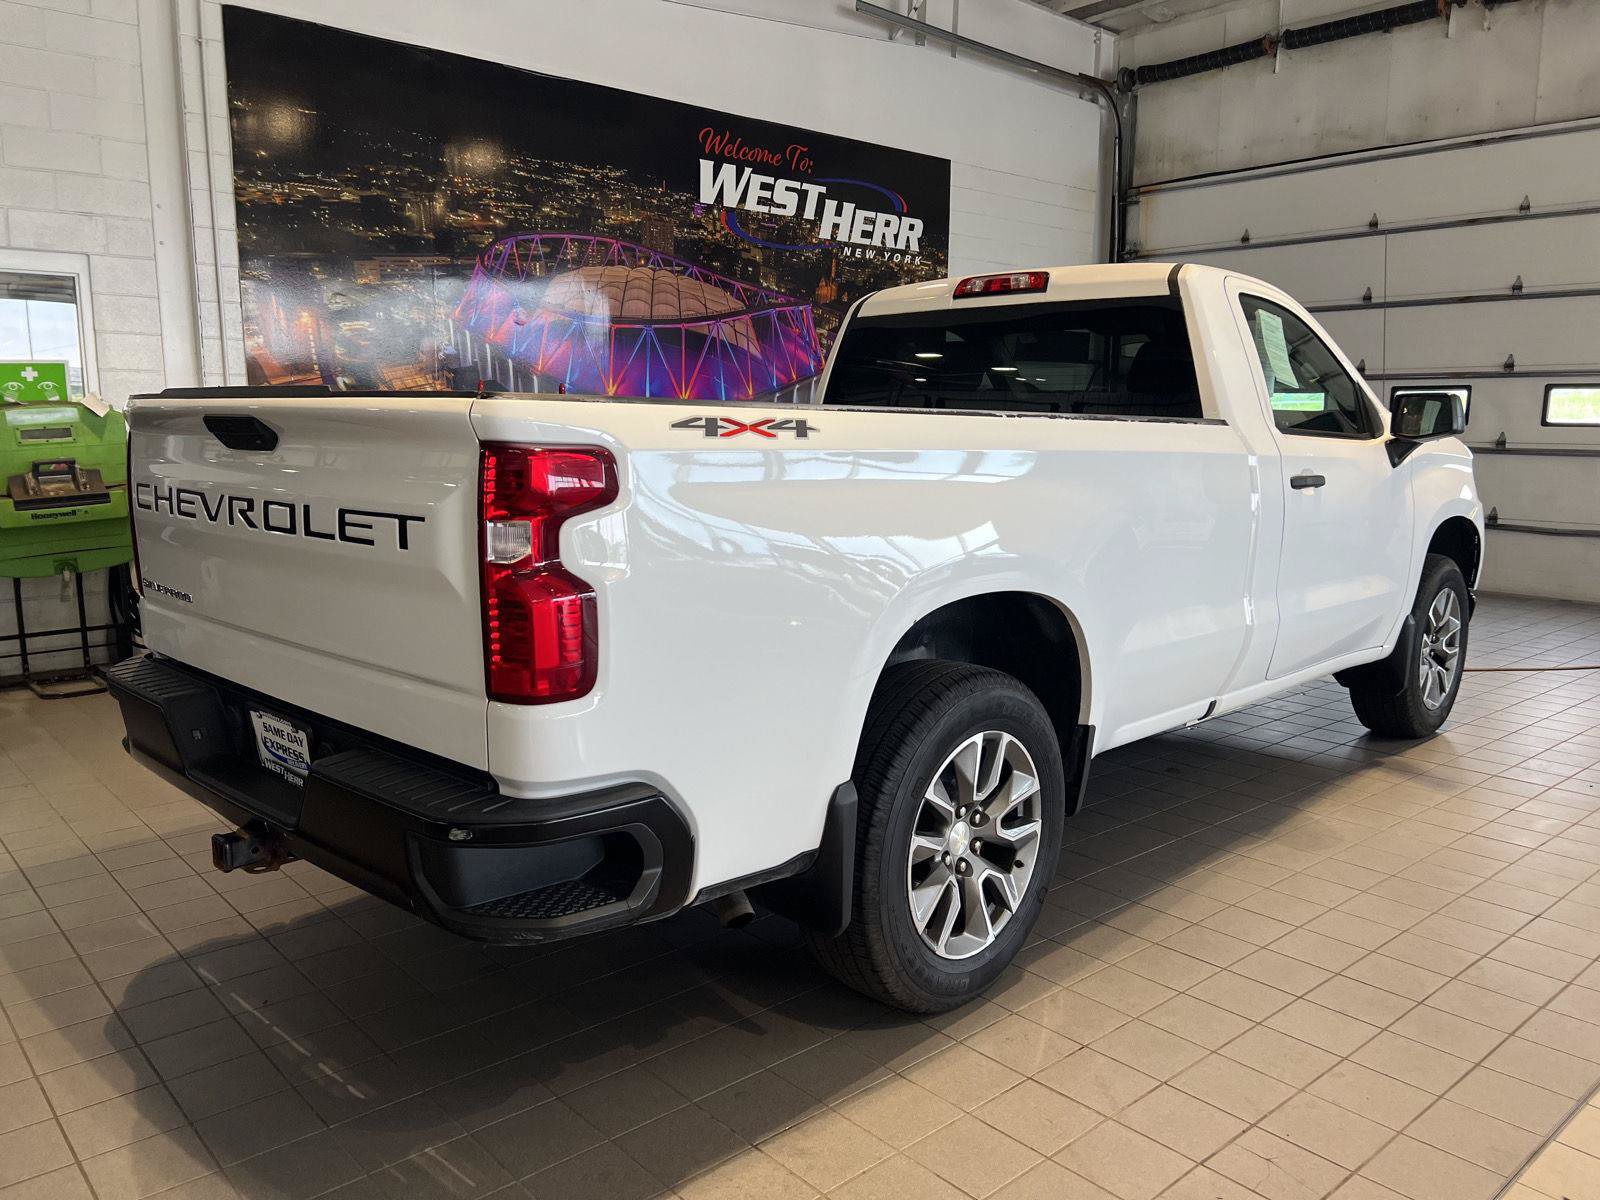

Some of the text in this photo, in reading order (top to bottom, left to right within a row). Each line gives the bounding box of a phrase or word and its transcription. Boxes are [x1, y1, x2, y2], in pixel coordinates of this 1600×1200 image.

[699, 127, 814, 174] Welcome To:
[699, 159, 924, 251] WEST HERR
[843, 246, 922, 264] NEW YORK
[31, 510, 77, 520] Honeywell
[136, 482, 425, 550] CHEVROLET
[262, 722, 304, 748] SAME DAY
[263, 736, 305, 763] EXPRESS
